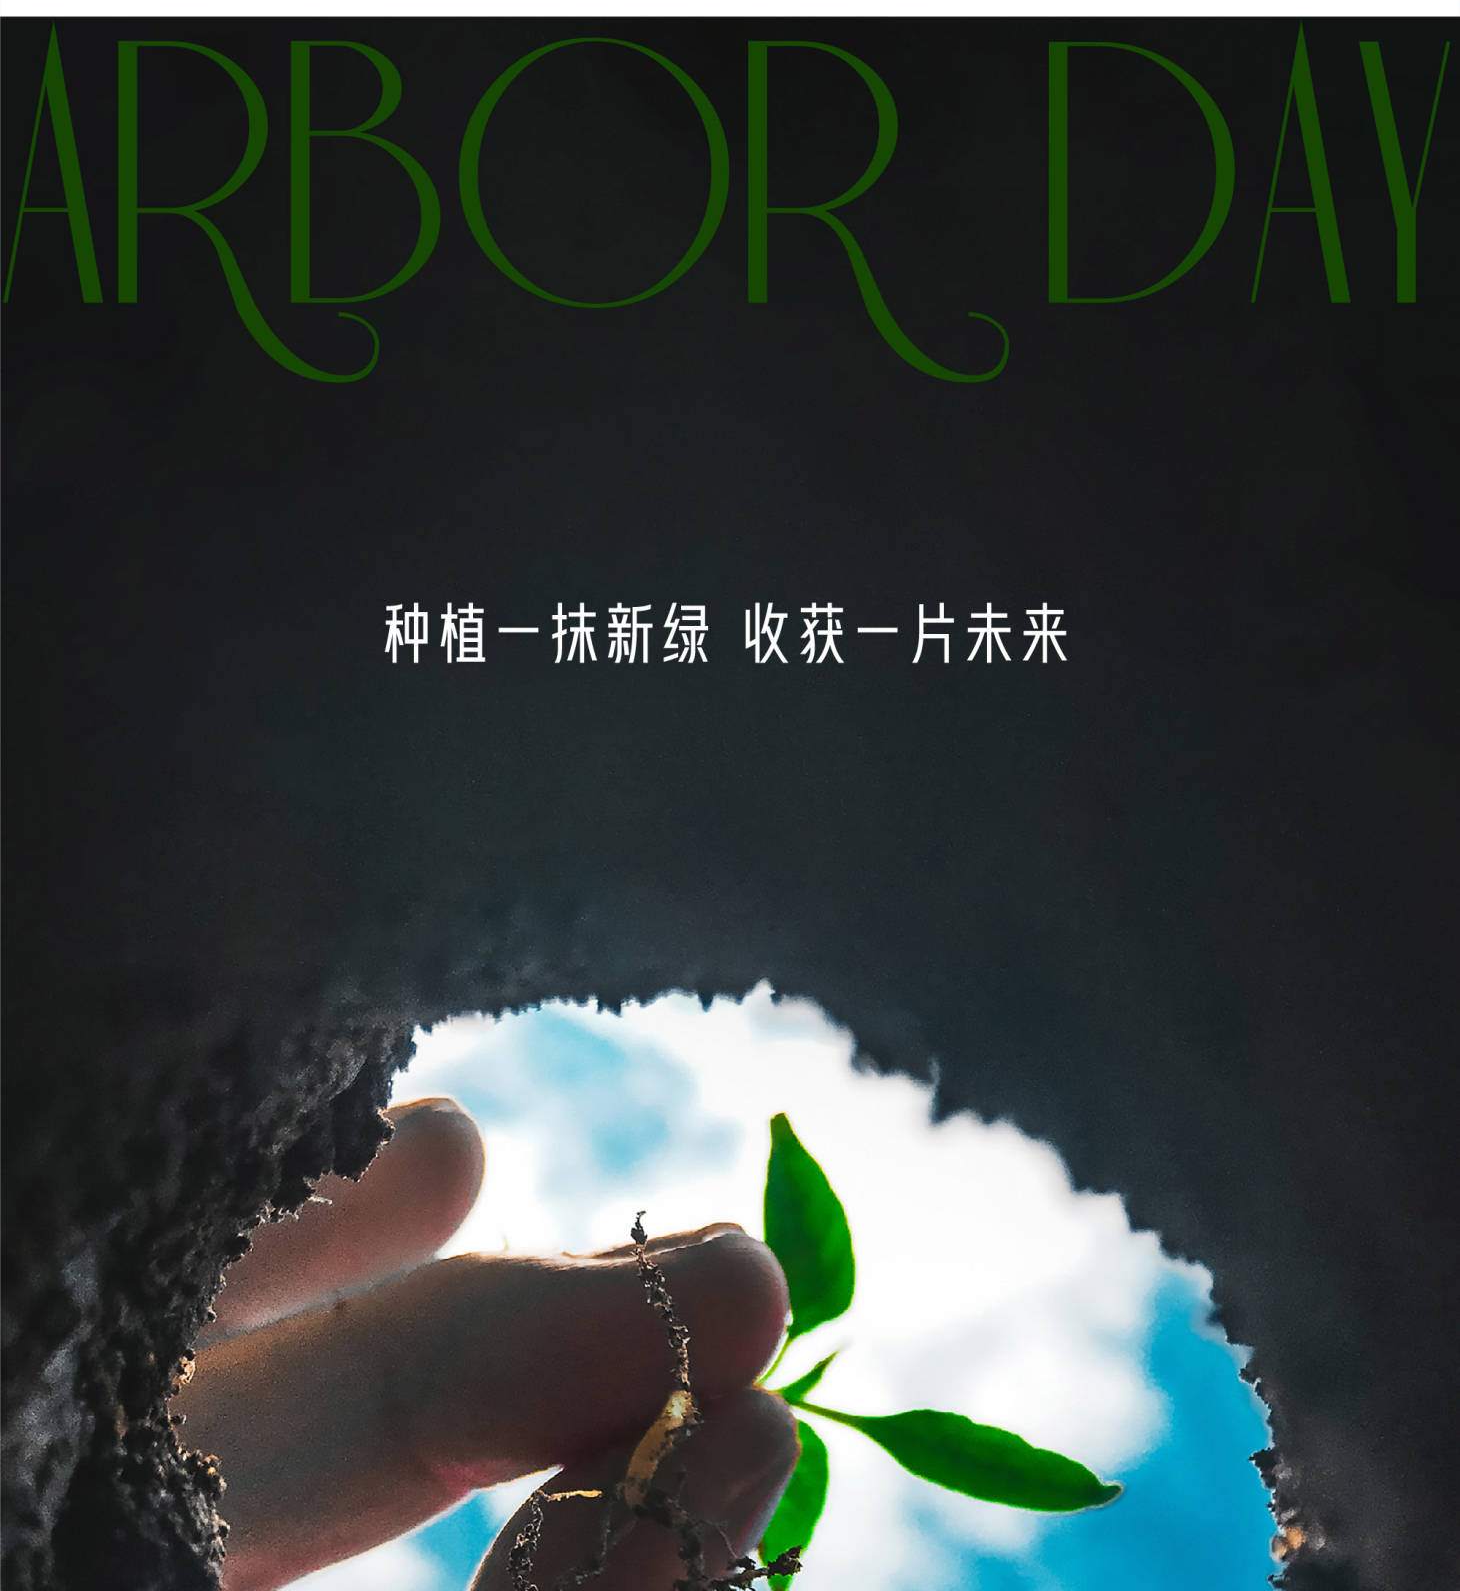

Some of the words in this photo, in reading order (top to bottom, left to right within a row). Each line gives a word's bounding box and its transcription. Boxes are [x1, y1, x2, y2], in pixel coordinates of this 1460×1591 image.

[4, 23, 1009, 383] ARBOR
[1049, 23, 1450, 303] DAY
[385, 602, 709, 664] 种植一抹新绿
[745, 602, 1067, 664] 收获一片未来
